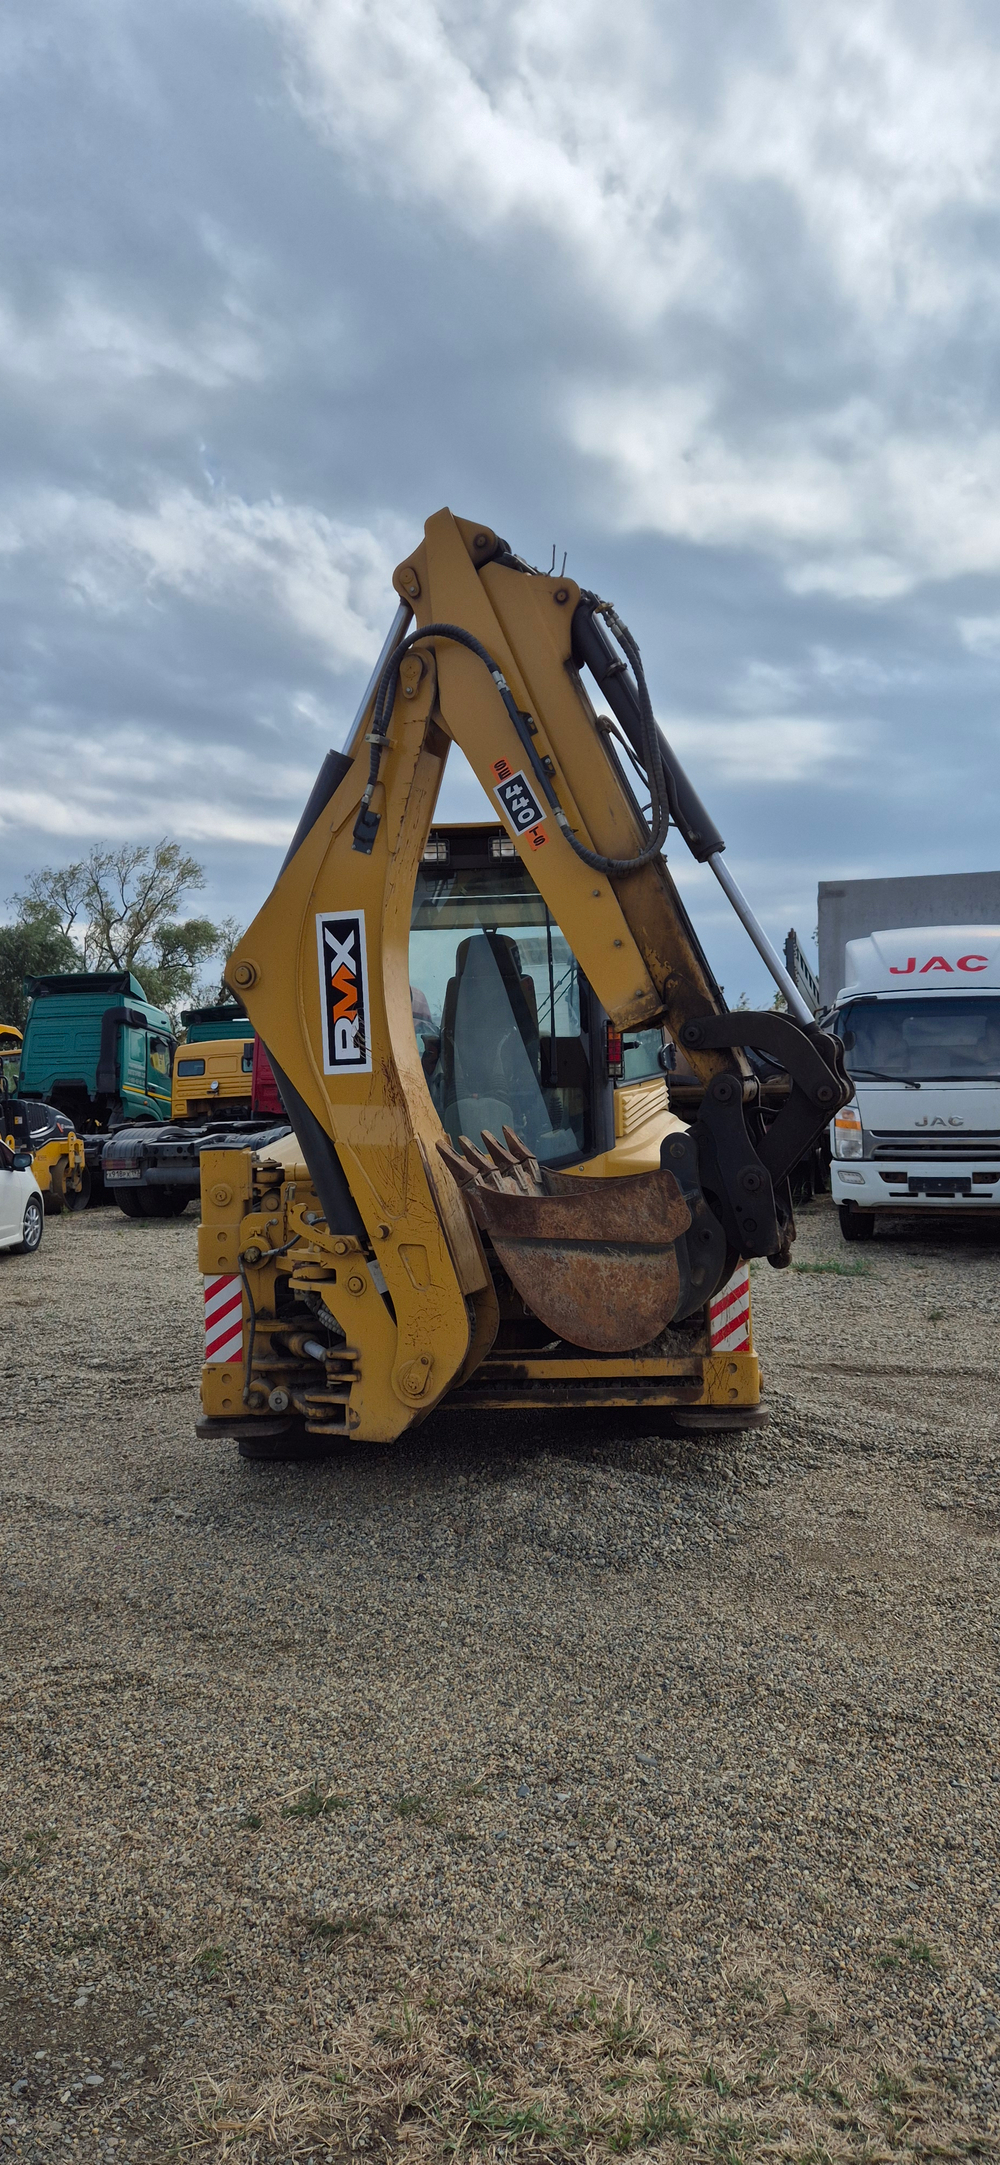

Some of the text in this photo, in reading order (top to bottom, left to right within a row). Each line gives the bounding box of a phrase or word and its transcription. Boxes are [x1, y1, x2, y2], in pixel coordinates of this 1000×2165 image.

[494, 759, 546, 846] SE 440 TS
[889, 954, 989, 974] JAC
[324, 927, 361, 1060] RMX
[914, 1115, 964, 1127] JAC
